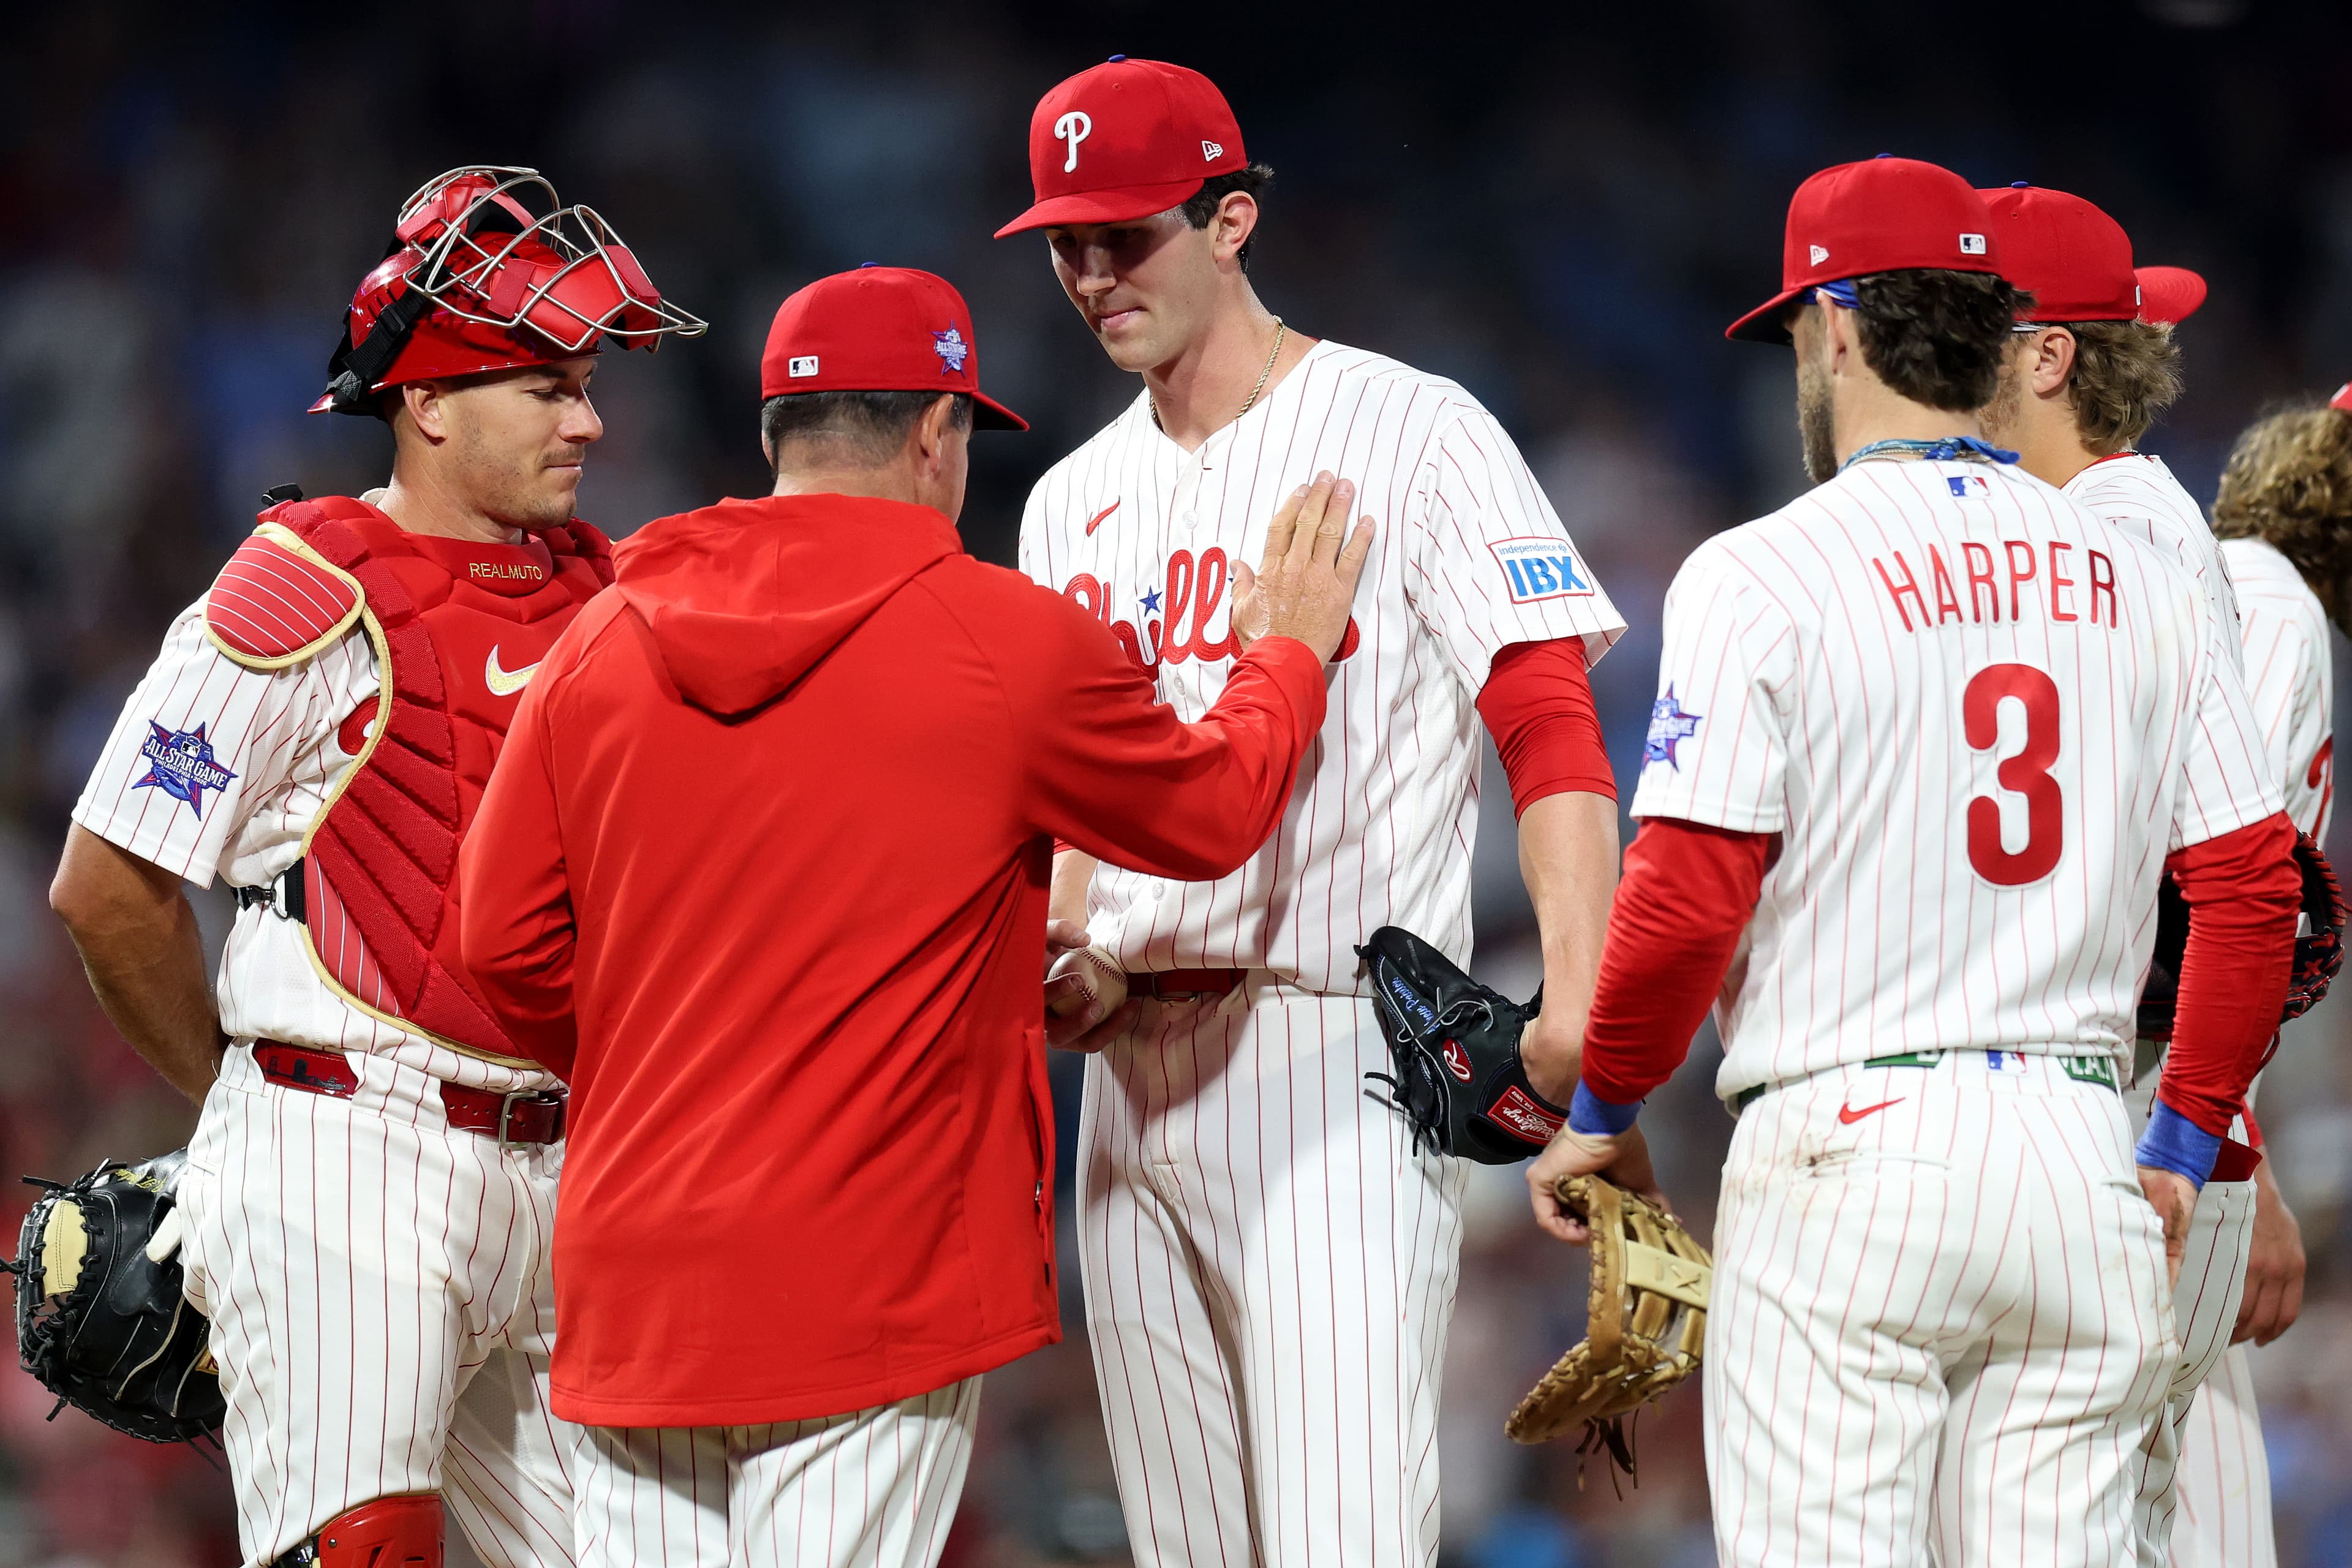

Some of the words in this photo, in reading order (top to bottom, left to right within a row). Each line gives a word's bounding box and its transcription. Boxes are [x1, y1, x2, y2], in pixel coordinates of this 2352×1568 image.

[1054, 111, 1091, 173] P
[469, 563, 543, 580] REALMUTO
[1505, 556, 1588, 597] IBX
[1873, 540, 2117, 633] HARPER
[145, 738, 167, 761] ALL
[165, 747, 195, 773] STAR
[193, 760, 228, 788] GAME
[155, 758, 191, 779] PHILADELPHIA
[193, 775, 208, 786] 2026
[1964, 663, 2063, 886] 3
